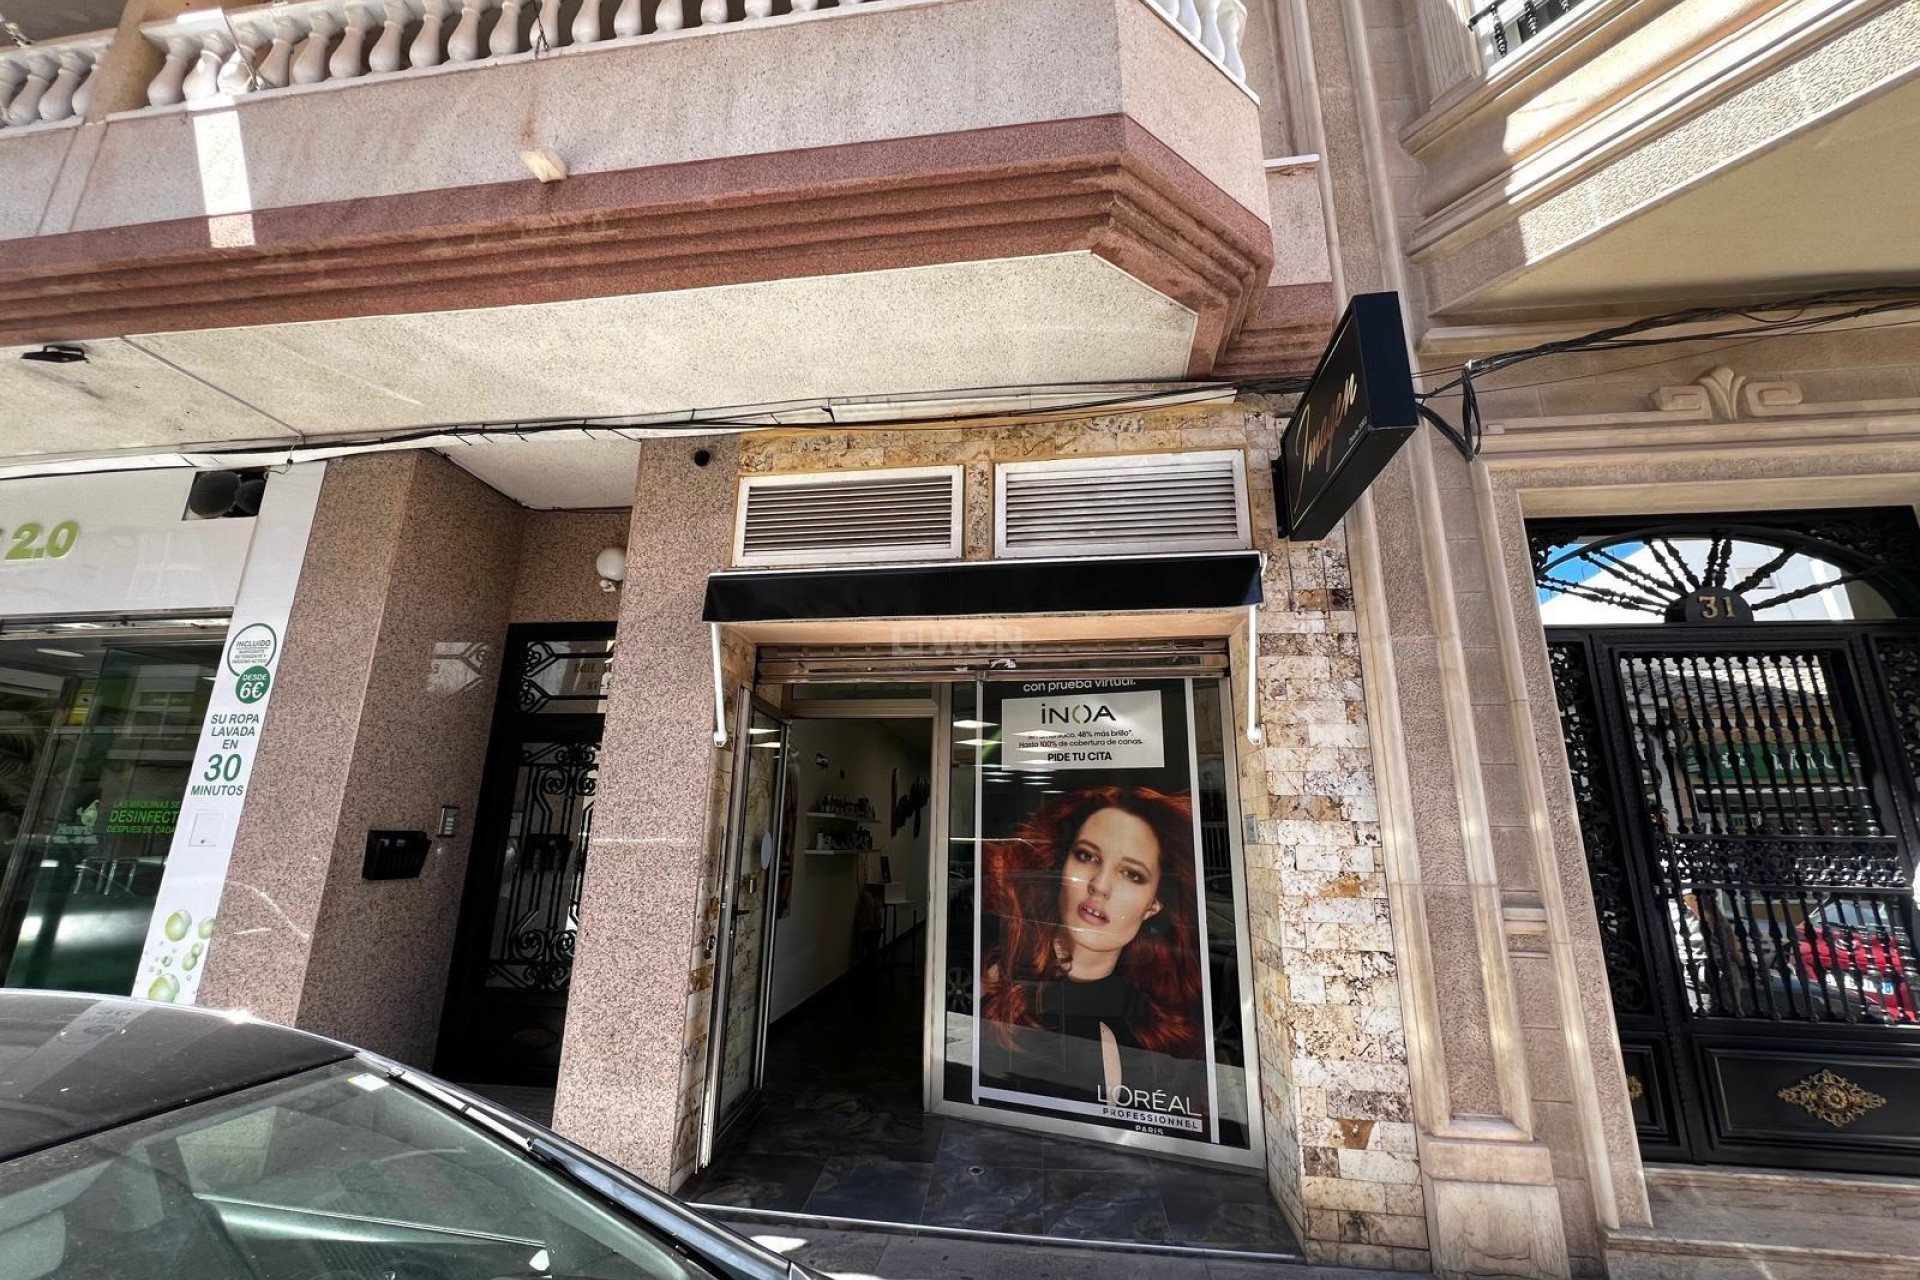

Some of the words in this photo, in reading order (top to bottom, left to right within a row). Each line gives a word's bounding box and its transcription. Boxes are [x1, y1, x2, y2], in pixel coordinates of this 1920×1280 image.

[4, 521, 79, 560] 2.0
[1699, 596, 1735, 618] 31
[240, 682, 264, 698] 6€
[1023, 682, 1046, 692] con
[1048, 680, 1092, 693] prueba
[211, 714, 227, 724] SU
[229, 714, 259, 724] ROPA
[211, 726, 255, 737] LAVADA
[222, 740, 239, 749] EN
[1040, 740, 1057, 748] 100%
[1069, 739, 1105, 747] cobertura
[1048, 752, 1071, 761] PIDE
[1072, 752, 1086, 761] TU
[1087, 751, 1112, 761] CITA
[204, 754, 242, 781] 30
[191, 785, 244, 796] MINUTOS
[1103, 1107, 1199, 1129] PROFESSIONNEL
[1135, 1124, 1164, 1136] PARIS
